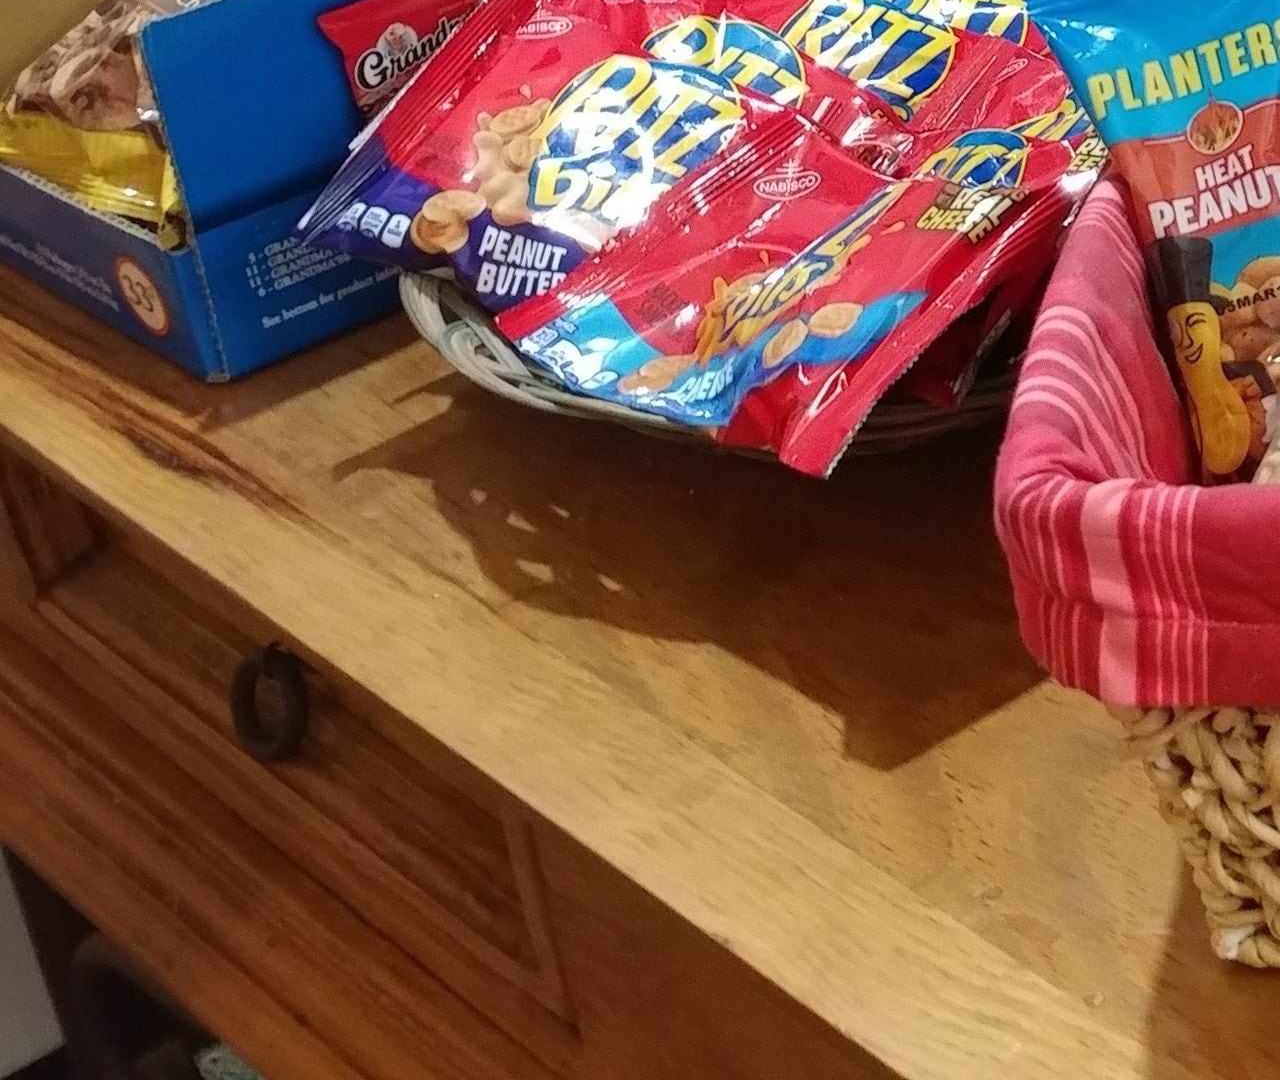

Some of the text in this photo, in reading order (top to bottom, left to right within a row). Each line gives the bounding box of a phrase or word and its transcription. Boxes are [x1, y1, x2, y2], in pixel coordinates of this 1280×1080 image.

[758, 176, 818, 196] NABISCO
[1194, 144, 1256, 189] HEAT
[478, 225, 568, 268] PEANUT
